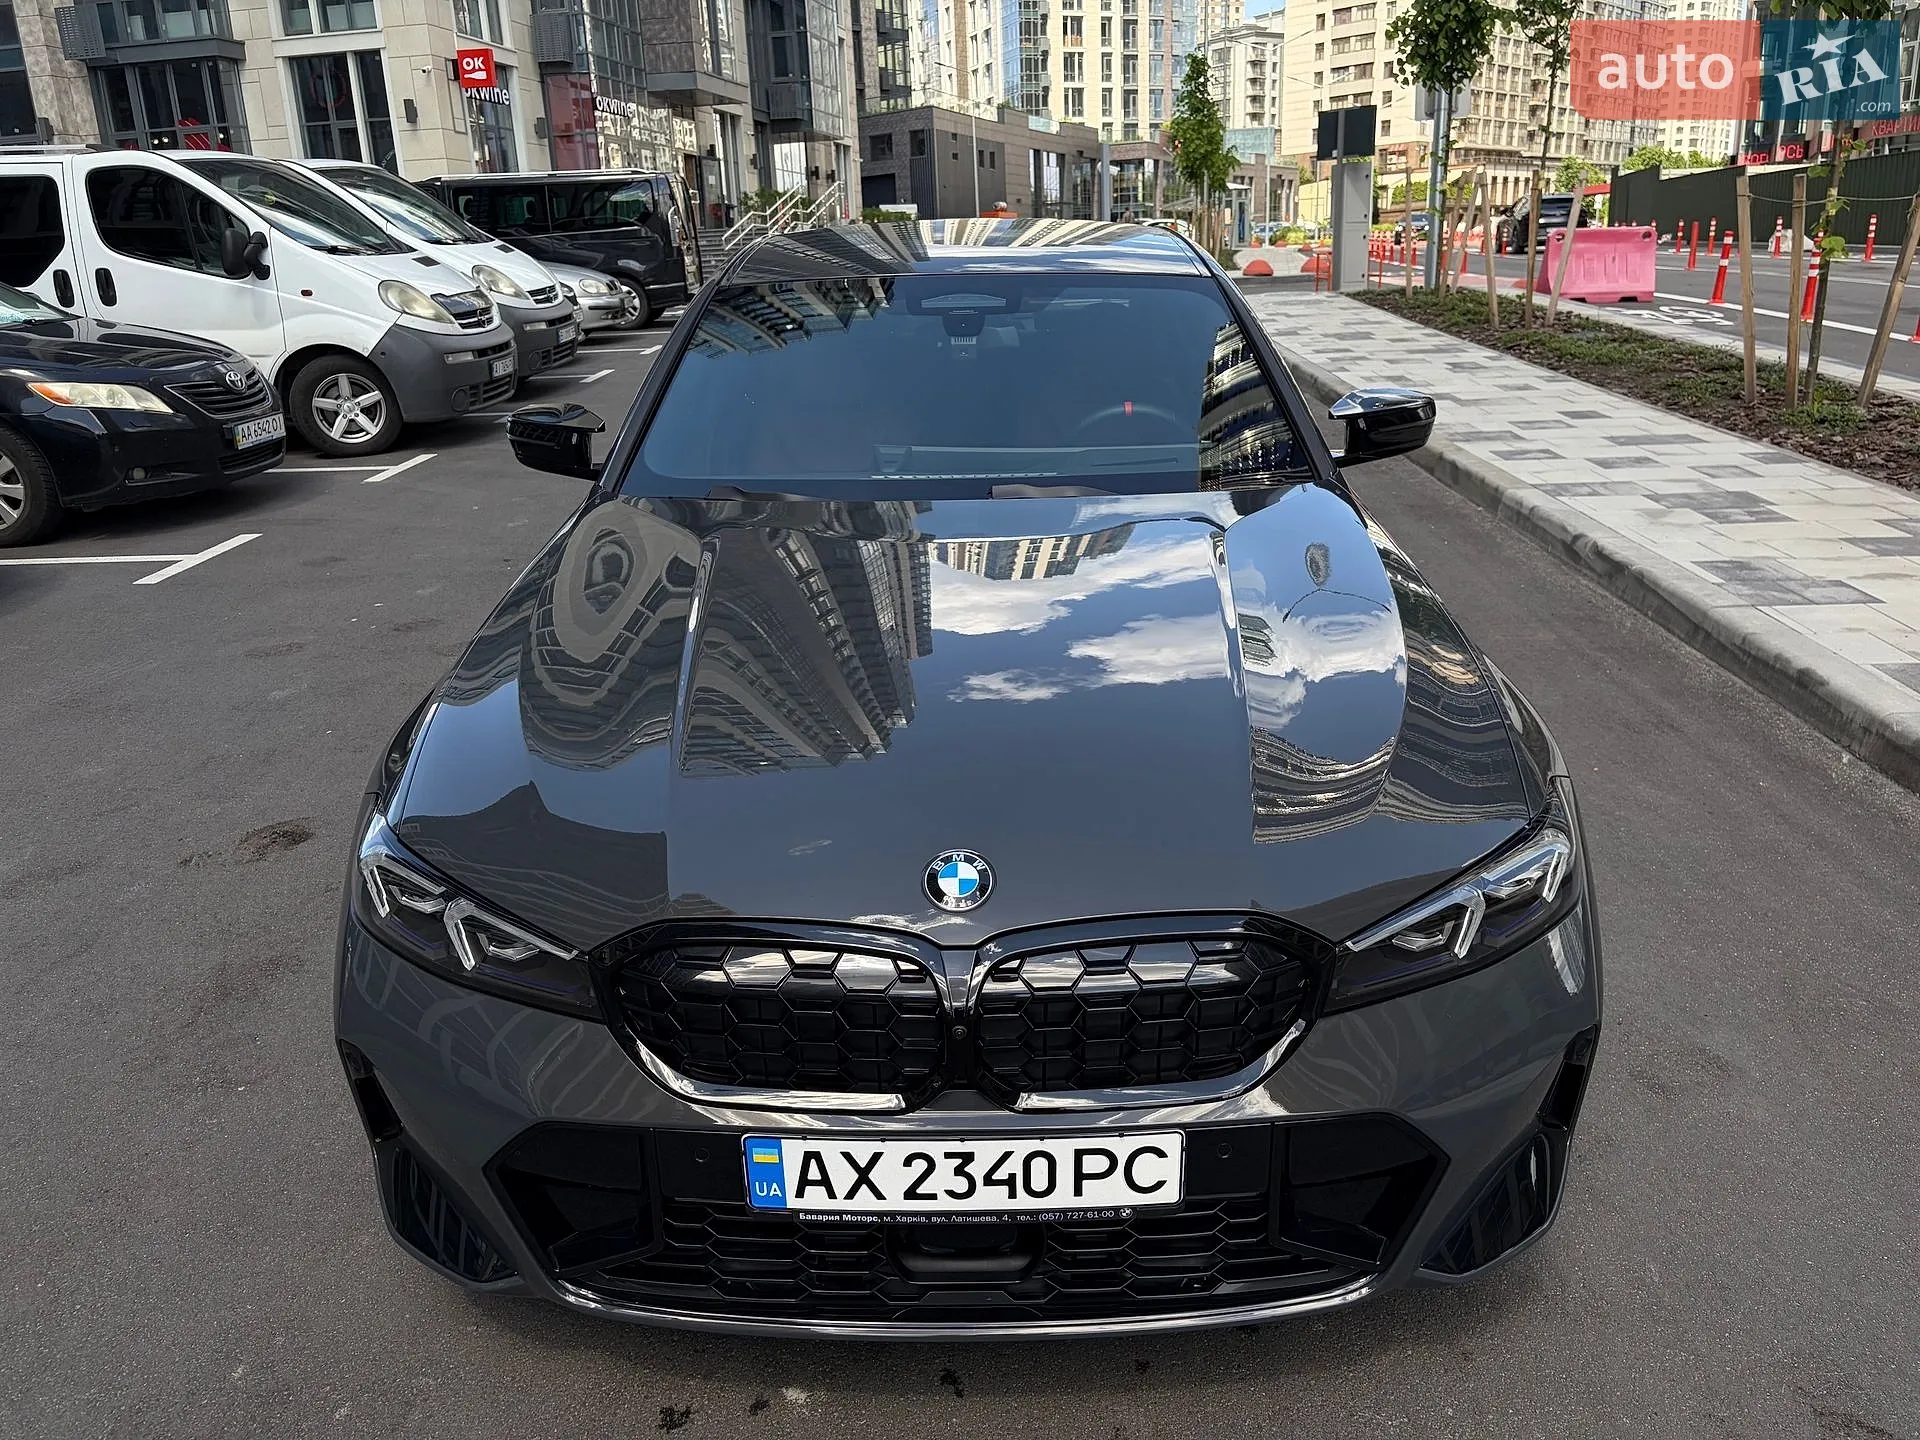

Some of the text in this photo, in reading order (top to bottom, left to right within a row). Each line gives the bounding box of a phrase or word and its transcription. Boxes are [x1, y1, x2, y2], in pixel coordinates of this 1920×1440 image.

[462, 56, 486, 71] OK
[932, 853, 986, 871] BMW
[795, 1145, 1168, 1201] AX 2340 PC
[755, 1181, 782, 1197] UA
[799, 1212, 840, 1222] Бавария
[842, 1214, 881, 1223] Моторс,
[895, 1214, 929, 1223] Харків,
[1038, 1212, 1064, 1221] (057)
[1066, 1209, 1115, 1220] 727-61-00
